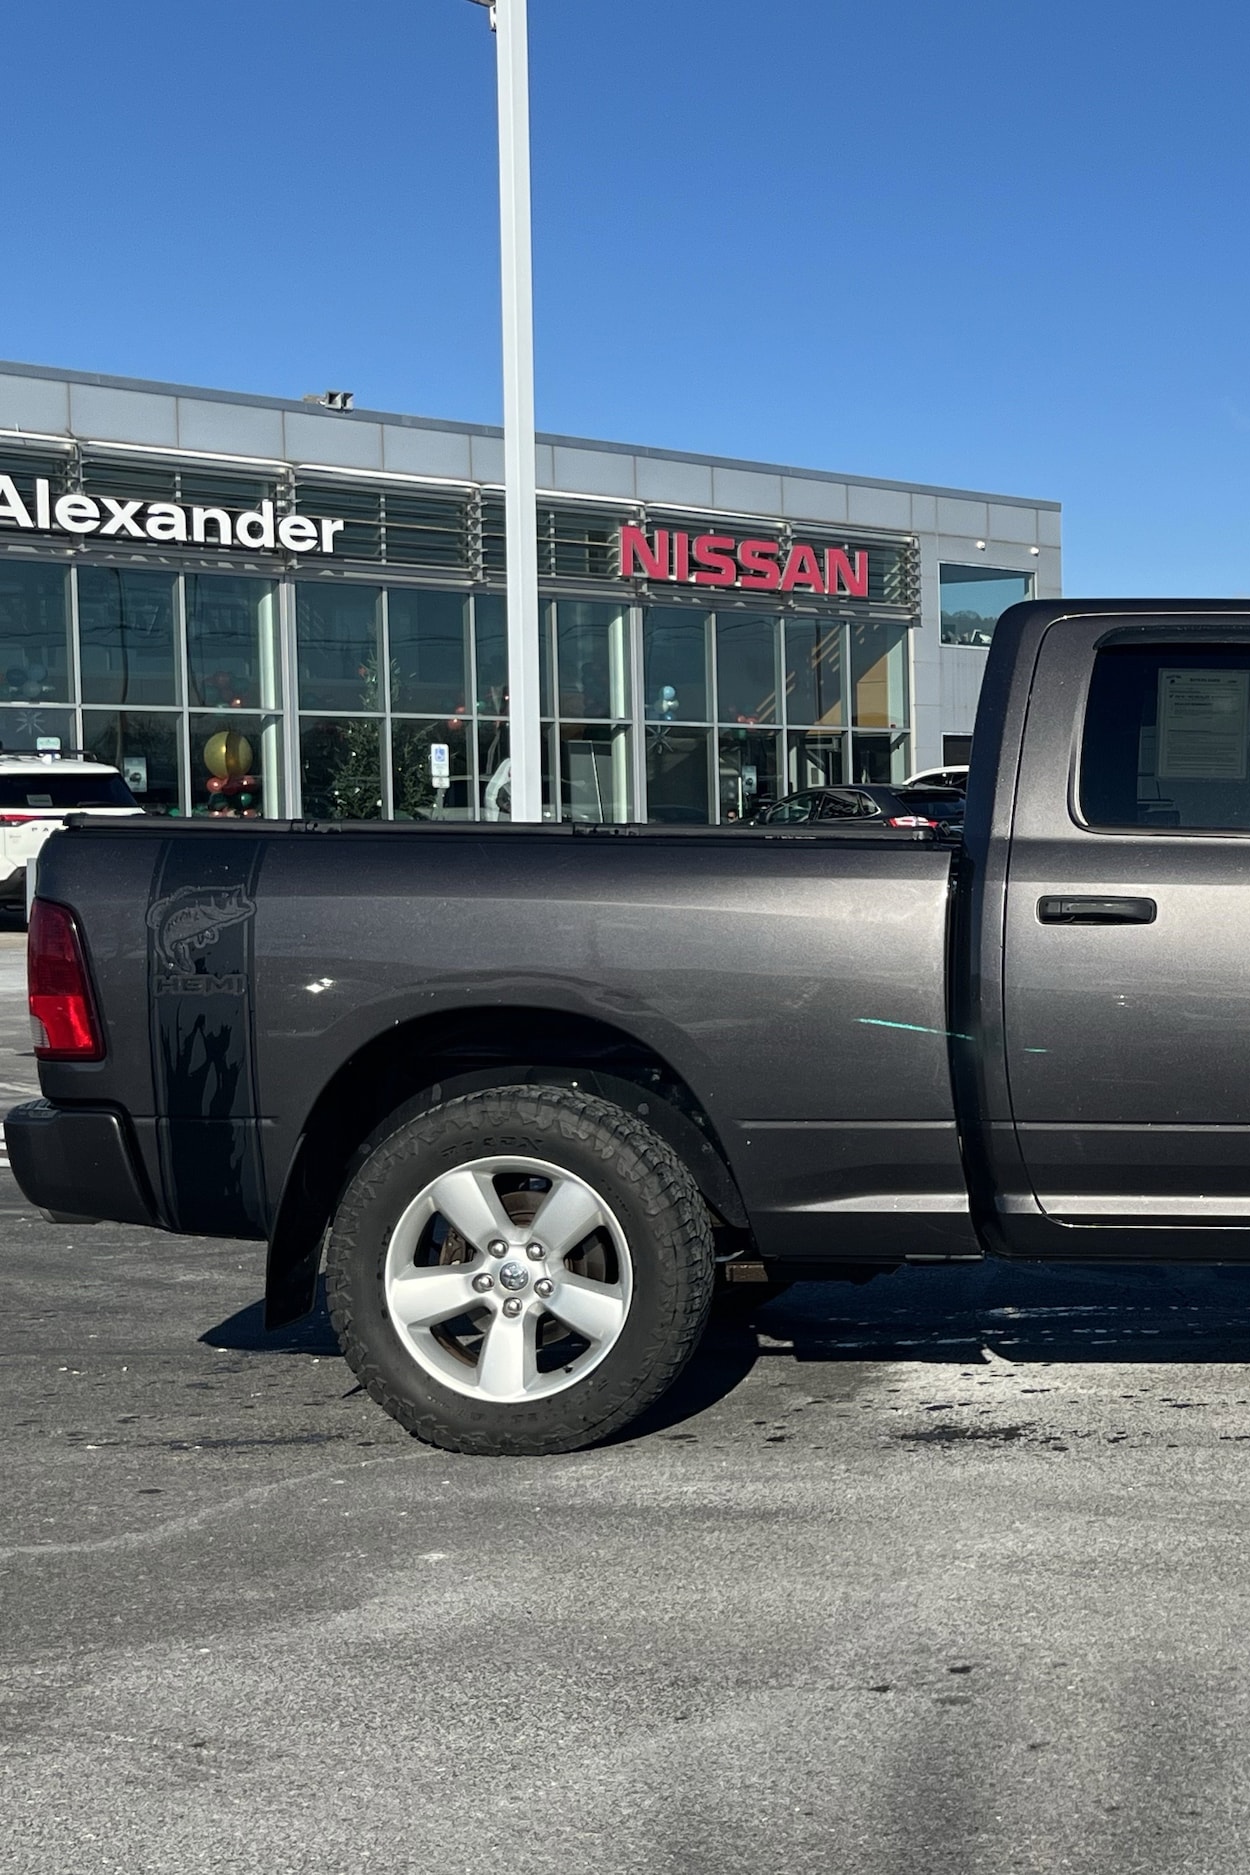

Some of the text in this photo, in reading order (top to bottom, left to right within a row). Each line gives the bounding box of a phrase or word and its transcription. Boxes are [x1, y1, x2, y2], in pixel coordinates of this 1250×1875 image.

[0, 474, 345, 553] Alexander
[619, 524, 869, 598] NISSAN
[154, 974, 247, 996] HEMI
